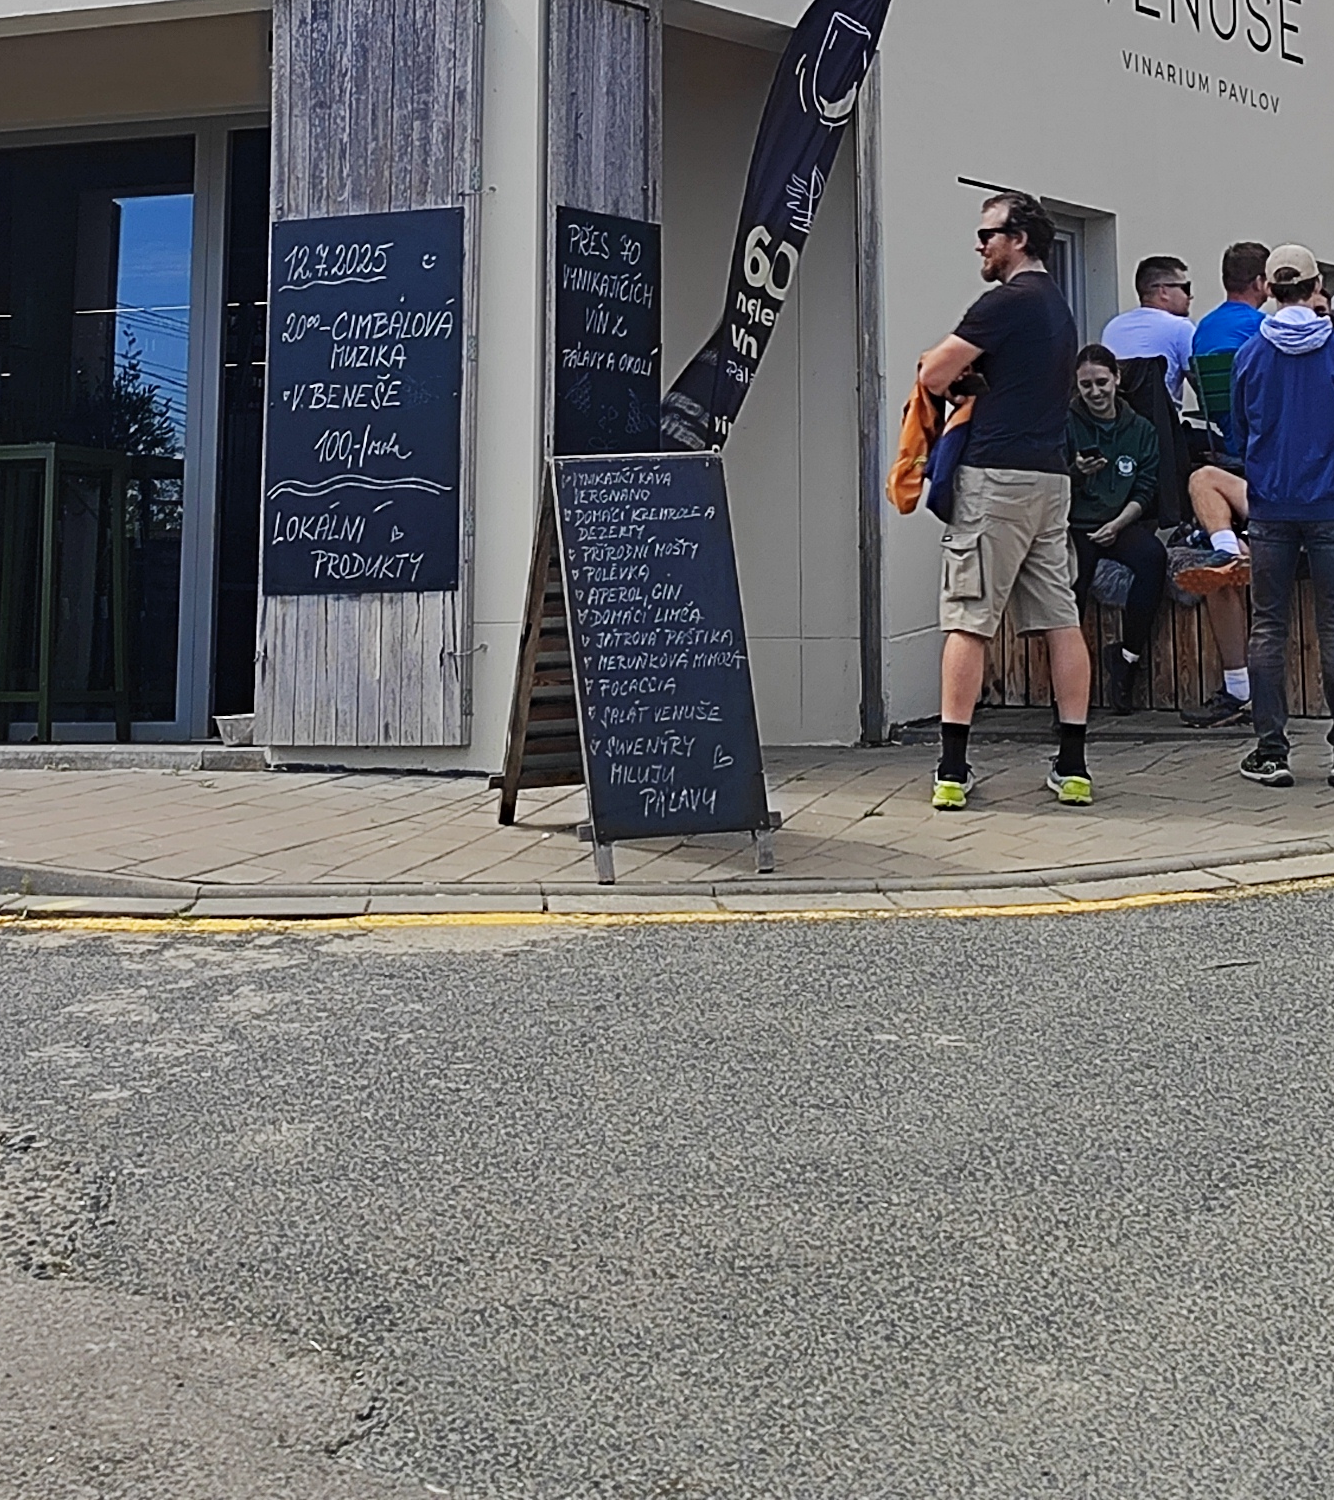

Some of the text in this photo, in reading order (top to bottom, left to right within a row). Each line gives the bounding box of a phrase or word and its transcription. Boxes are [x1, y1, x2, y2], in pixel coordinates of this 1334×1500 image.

[1122, 49, 1280, 113] VINARIUM PAVLOV
[568, 223, 641, 265] PŘES 70
[284, 242, 394, 282] 12.7.2025
[743, 225, 799, 300] 60
[563, 264, 654, 309] VYNIKAJÍCÍCH
[585, 303, 610, 334] VÍN
[330, 344, 407, 370] MUZIKA
[562, 342, 659, 376] PÁLAVY A OKOLÍ
[638, 465, 671, 487] KÁVA
[272, 501, 393, 545] LOKÁLNÍ
[575, 505, 630, 526] DOMÁCÍ
[704, 506, 715, 519] A
[577, 525, 645, 542] DEZERTY
[581, 536, 698, 562] PŘÍRODNÍ MOŠTY
[311, 550, 424, 582] PRODUKTY
[583, 564, 650, 582] POLÉVKA
[587, 583, 683, 608] APEROL, GIN
[591, 601, 705, 627] DOMÁCÍ LIMČA
[596, 628, 733, 648] JÁTROVÁ PAŠTIKA
[692, 650, 746, 670] MIMOZA
[599, 677, 676, 697] FOCACCIA
[601, 700, 723, 729] SALÁT VENUŠE
[605, 729, 695, 758] SUVENÝRY
[610, 762, 675, 785] MILUJU
